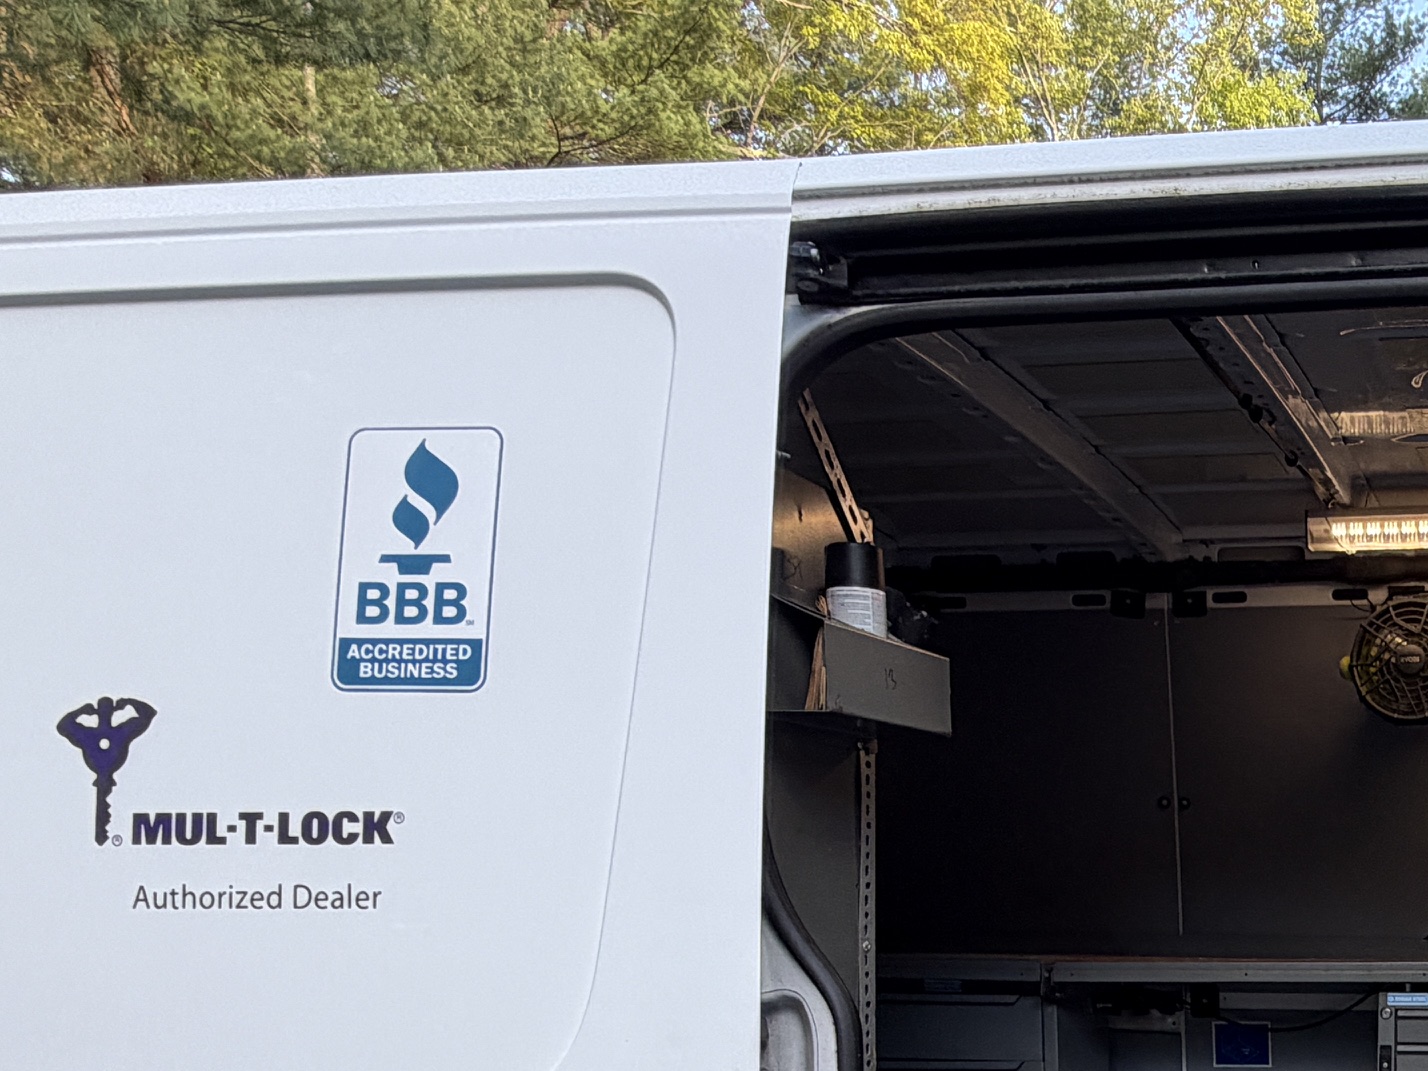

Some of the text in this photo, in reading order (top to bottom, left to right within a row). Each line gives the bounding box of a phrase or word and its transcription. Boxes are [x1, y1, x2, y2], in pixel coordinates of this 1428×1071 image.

[355, 581, 468, 625] BBB
[346, 643, 472, 660] ACCREDITED
[358, 662, 458, 679] BUSINESS
[132, 882, 383, 910] Authorized Dealer
